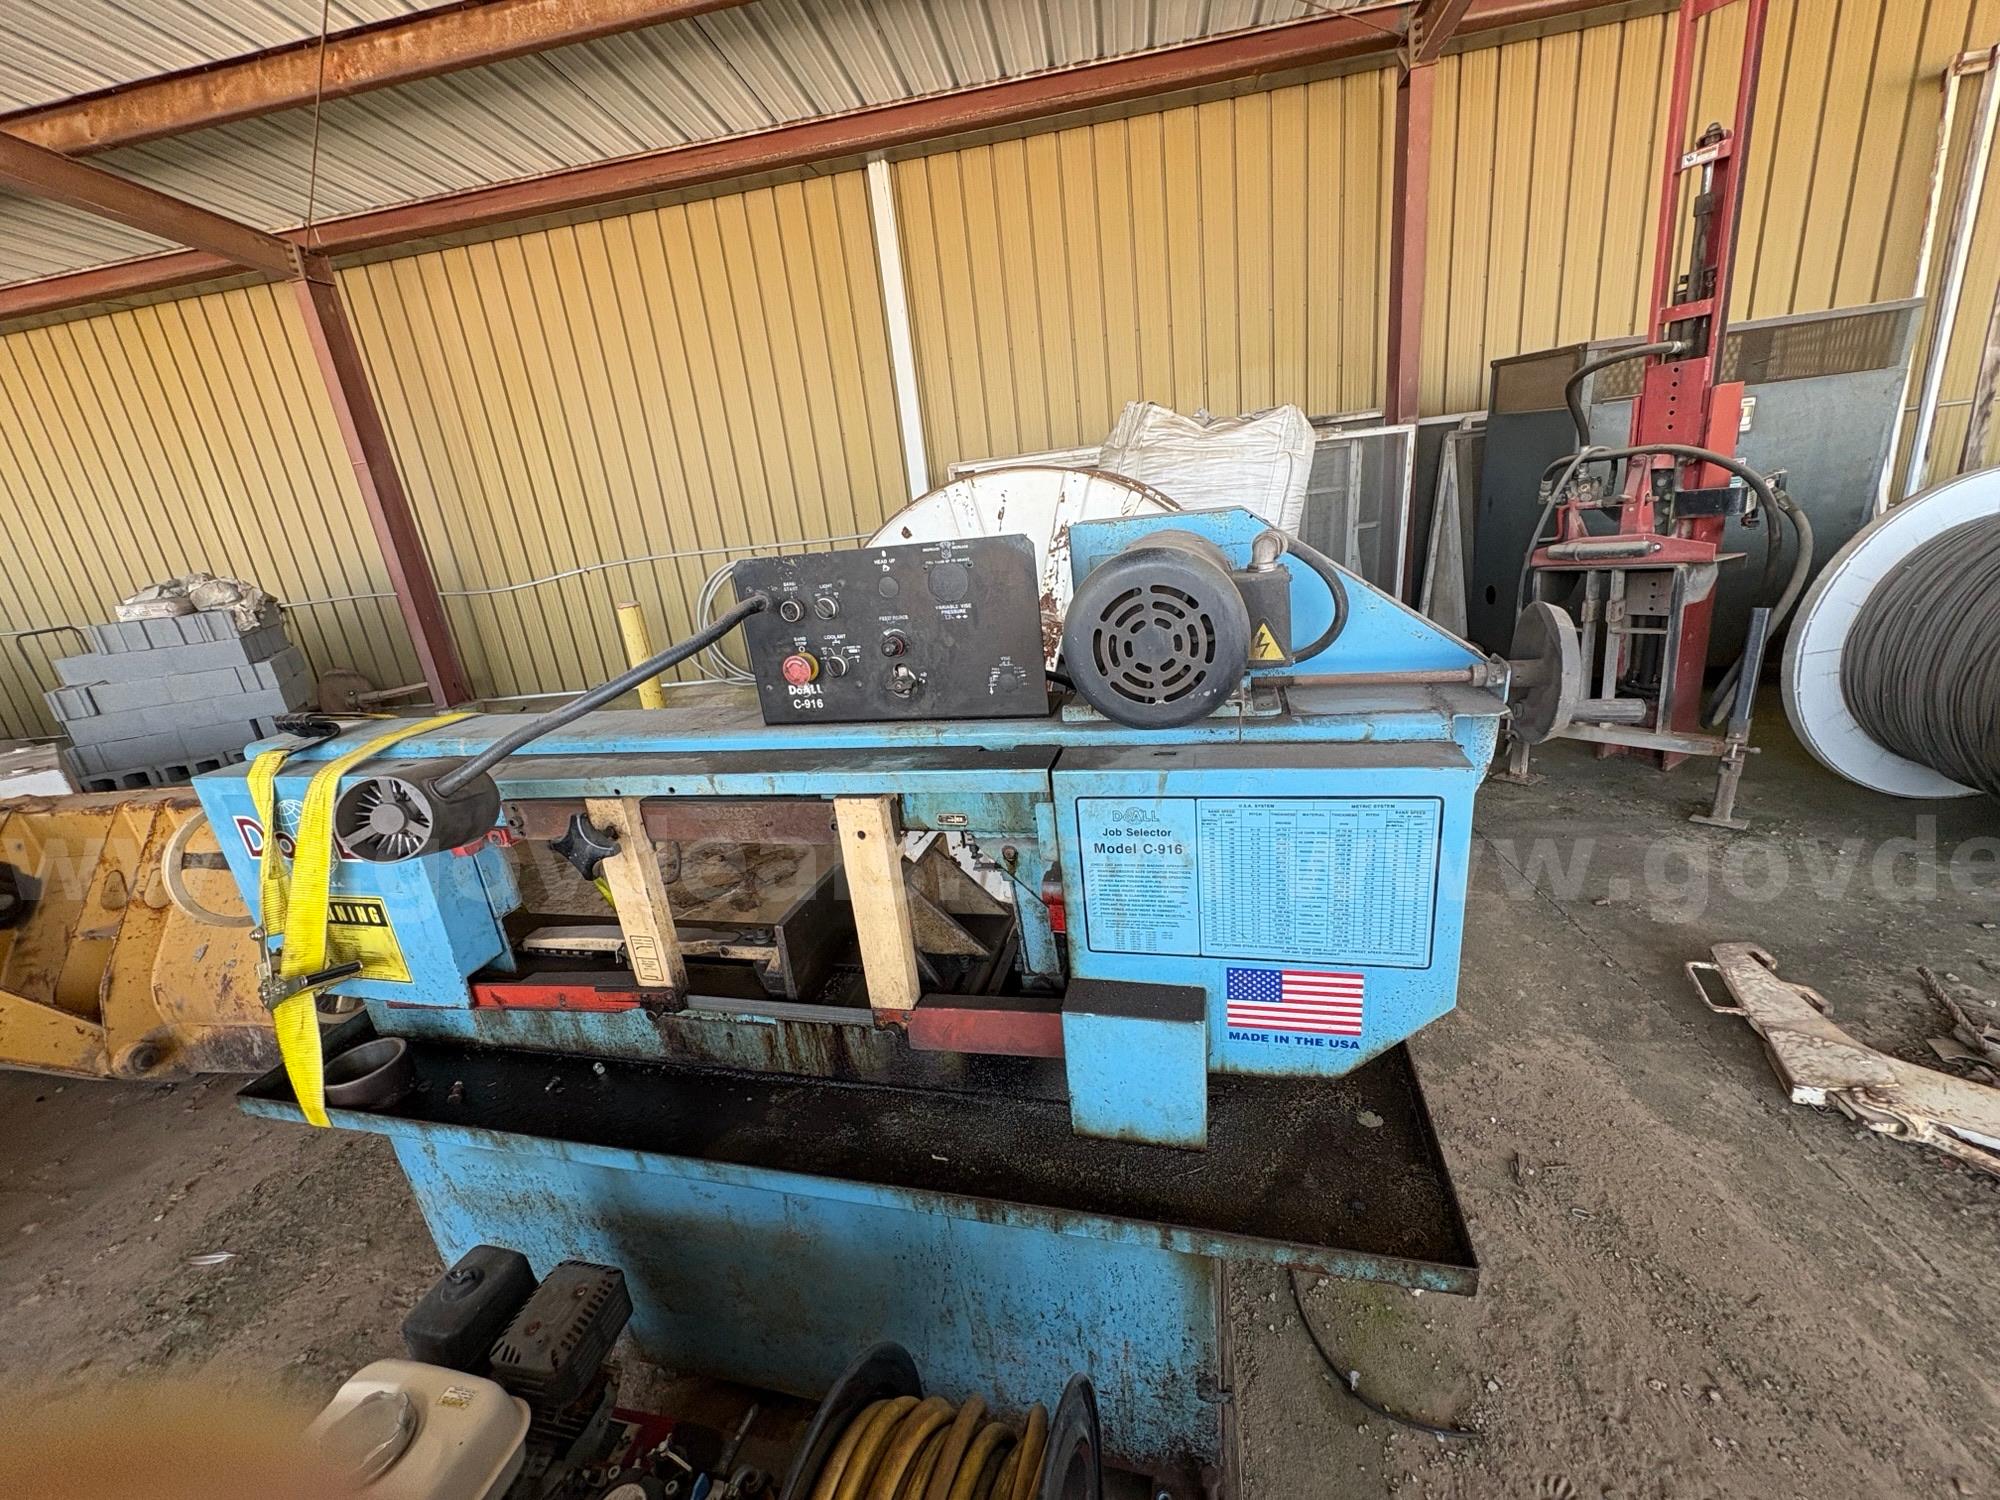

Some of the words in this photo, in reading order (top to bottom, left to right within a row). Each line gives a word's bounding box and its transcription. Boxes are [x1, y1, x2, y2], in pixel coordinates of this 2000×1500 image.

[793, 699, 824, 709] C-916
[1102, 827, 1122, 837] Job
[1126, 827, 1172, 837] Selector
[1094, 843, 1137, 854] Model
[1143, 843, 1183, 855] C-916
[1228, 1031, 1269, 1042] MADE
[1274, 1035, 1289, 1044] IN
[1294, 1036, 1324, 1047] THE
[1328, 1039, 1360, 1049] USA
